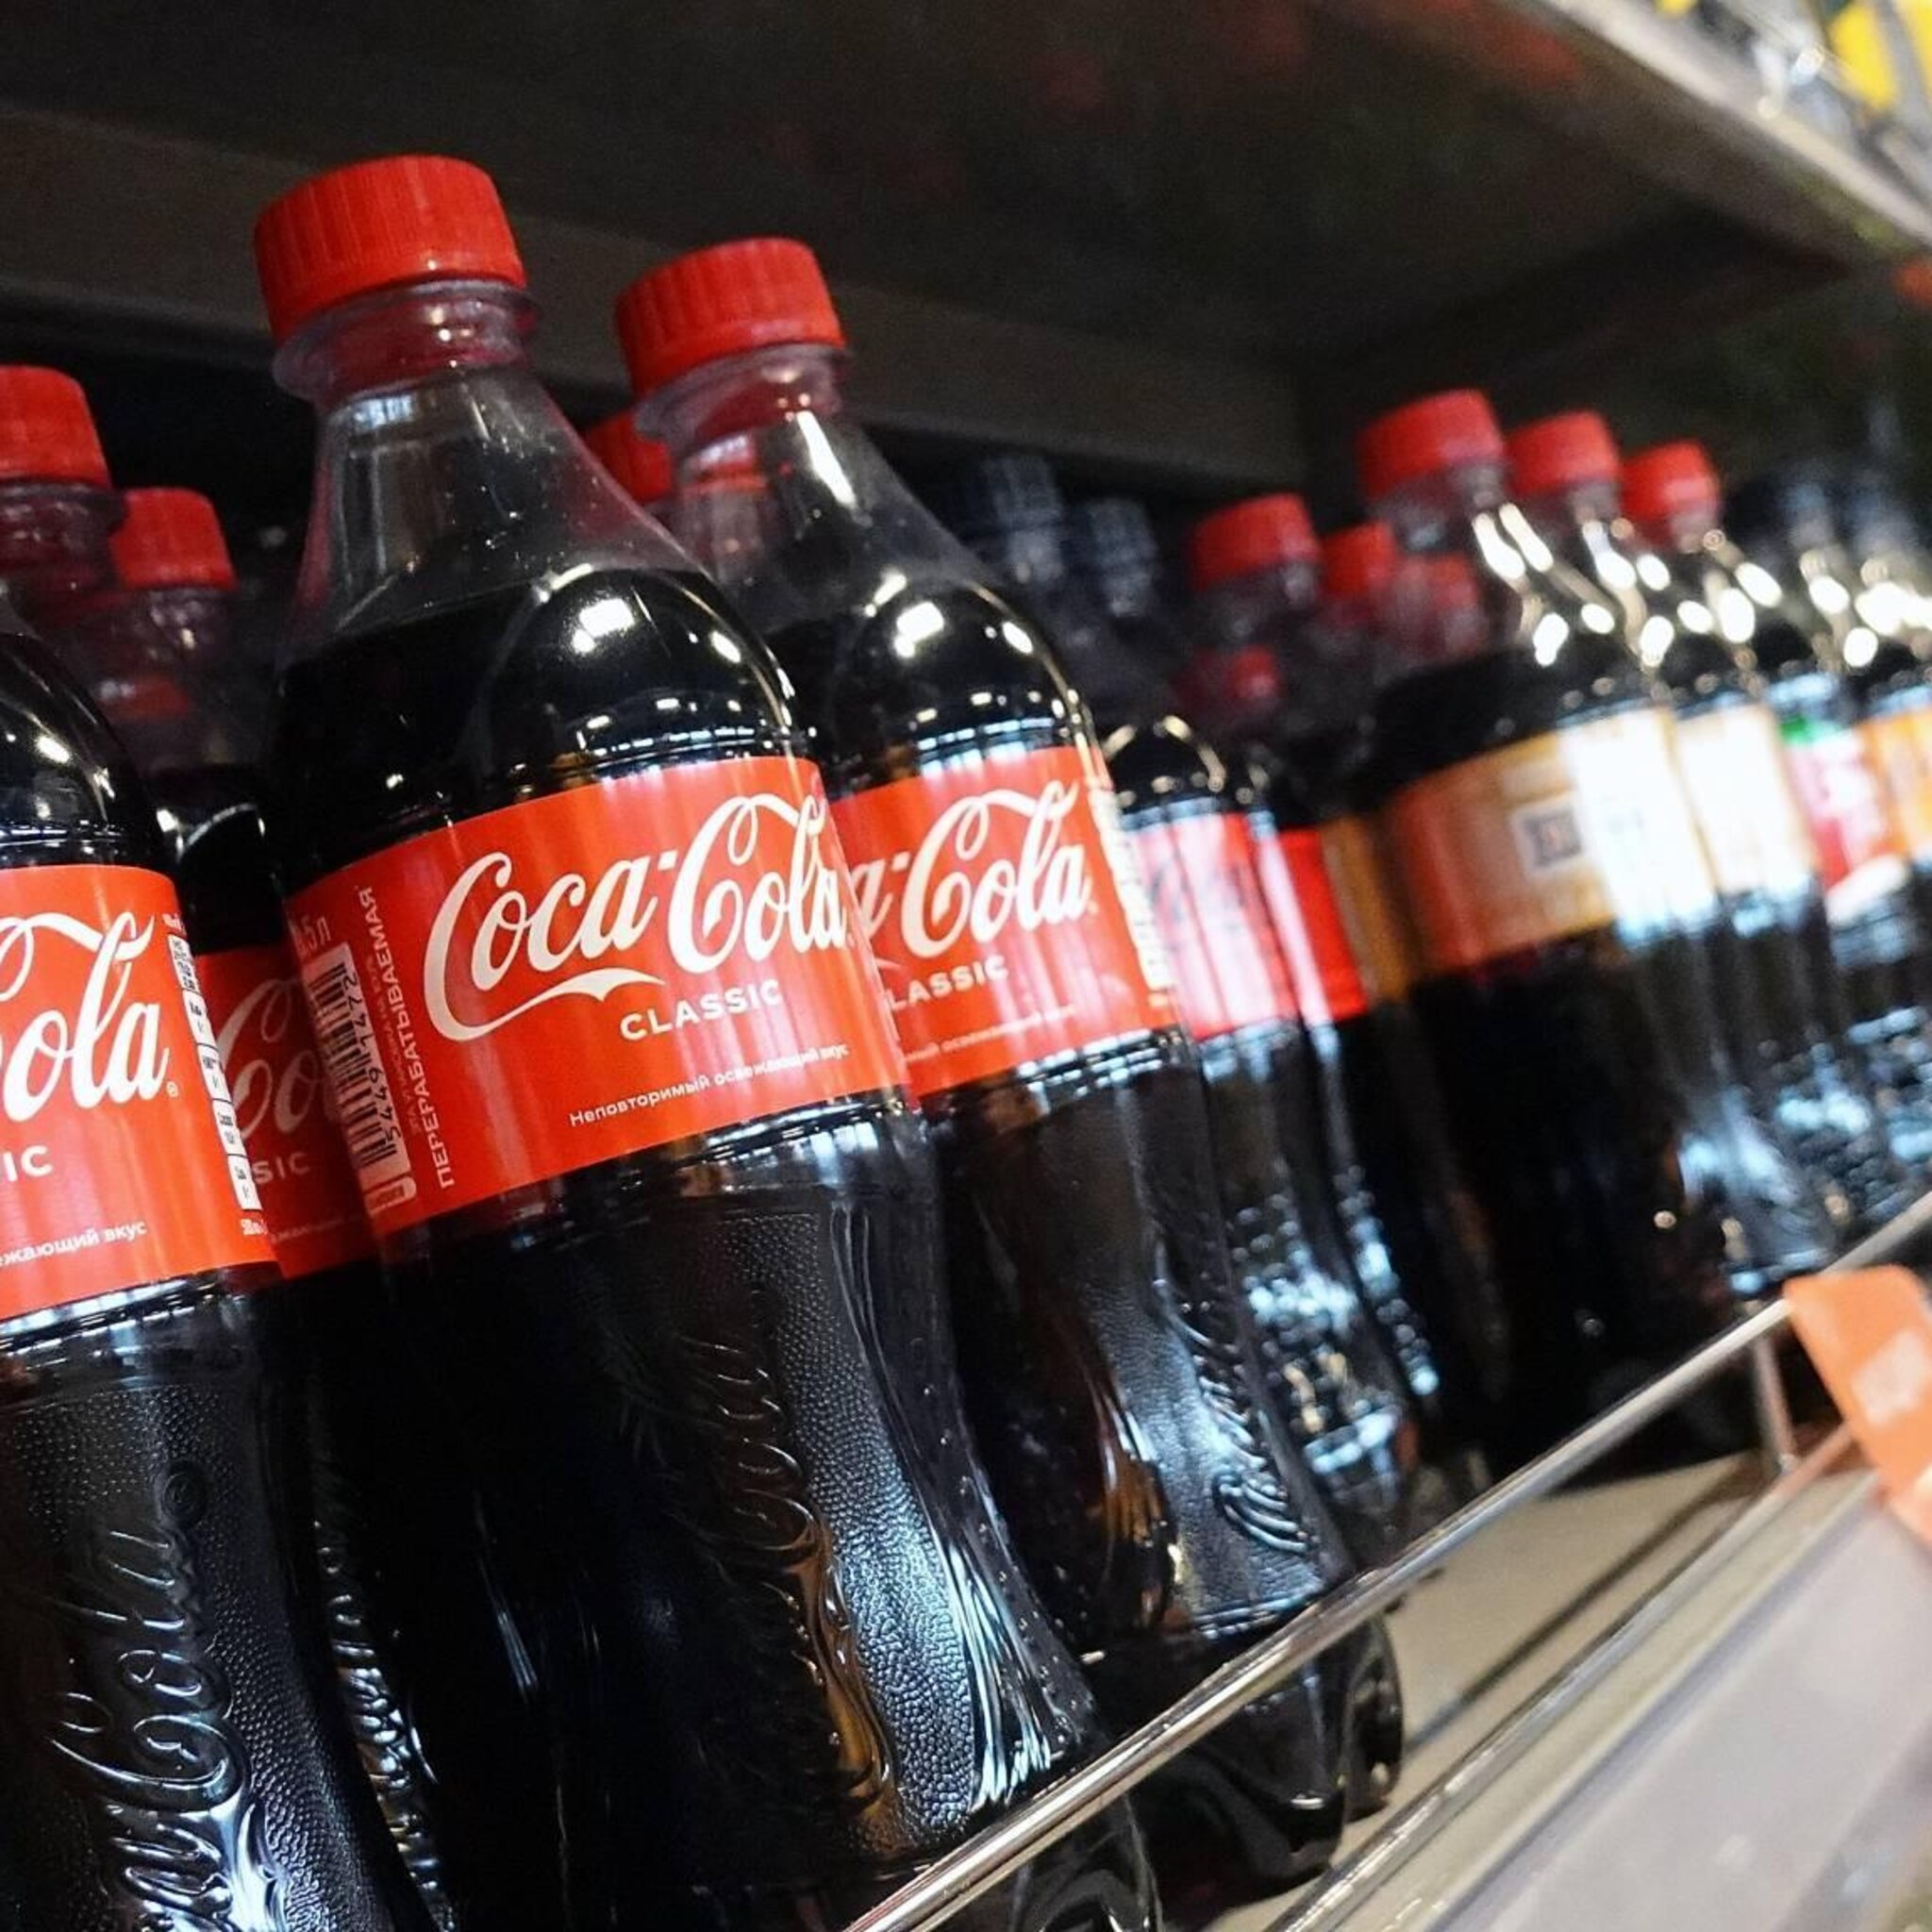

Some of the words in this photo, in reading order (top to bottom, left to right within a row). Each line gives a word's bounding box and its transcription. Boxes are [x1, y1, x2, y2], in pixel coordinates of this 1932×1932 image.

[424, 792, 847, 1041] Coca-Cola
[358, 886, 455, 1189] ПЕРЕРАБАТЫВАЕМАЯ
[620, 979, 782, 1042] CLASSIC
[569, 1075, 710, 1127] Неповторимый
[103, 1222, 148, 1242] вкус
